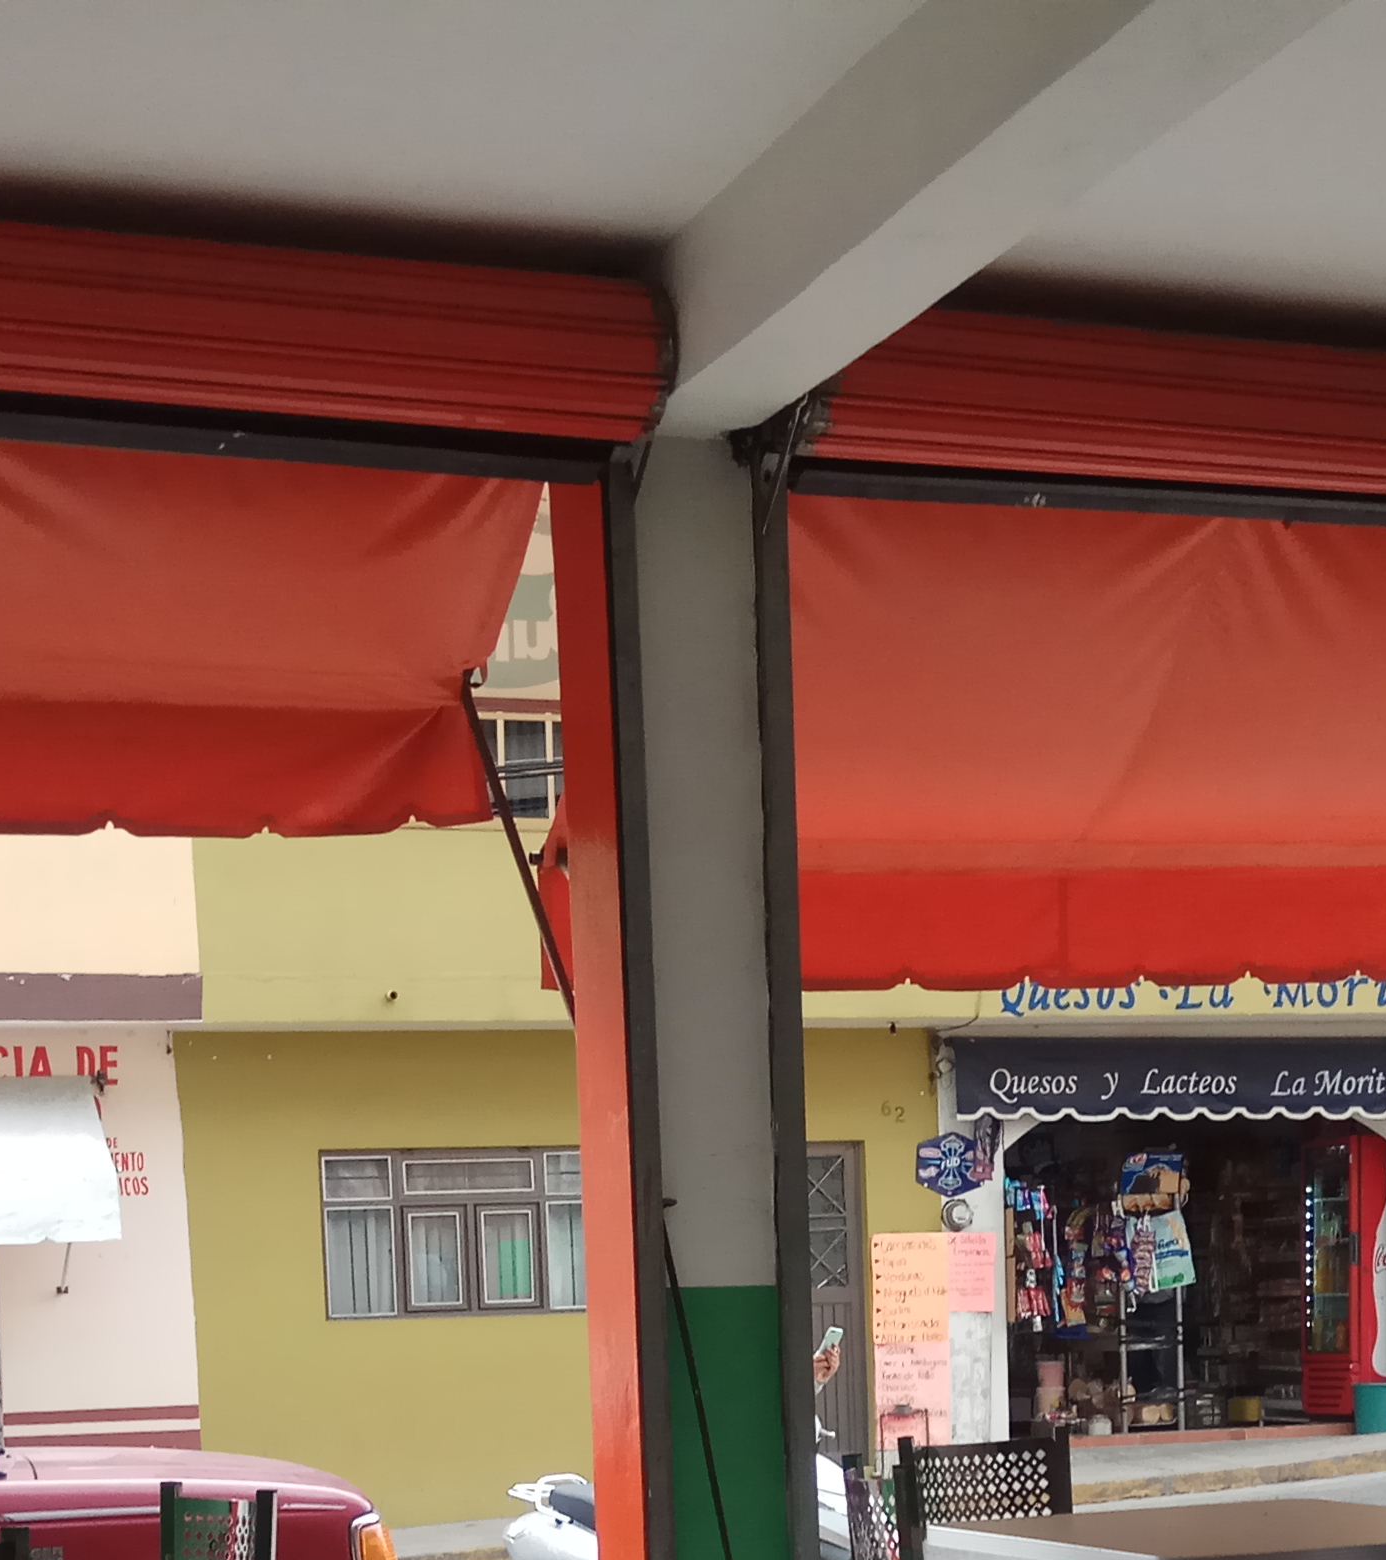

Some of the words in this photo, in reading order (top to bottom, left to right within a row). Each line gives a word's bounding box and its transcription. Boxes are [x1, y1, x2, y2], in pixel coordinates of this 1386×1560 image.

[75, 1045, 118, 1086] DE
[989, 1067, 1078, 1104] Quesos
[1100, 1070, 1119, 1101] y
[1140, 1067, 1238, 1095] Lacteos
[1270, 1070, 1307, 1097] La
